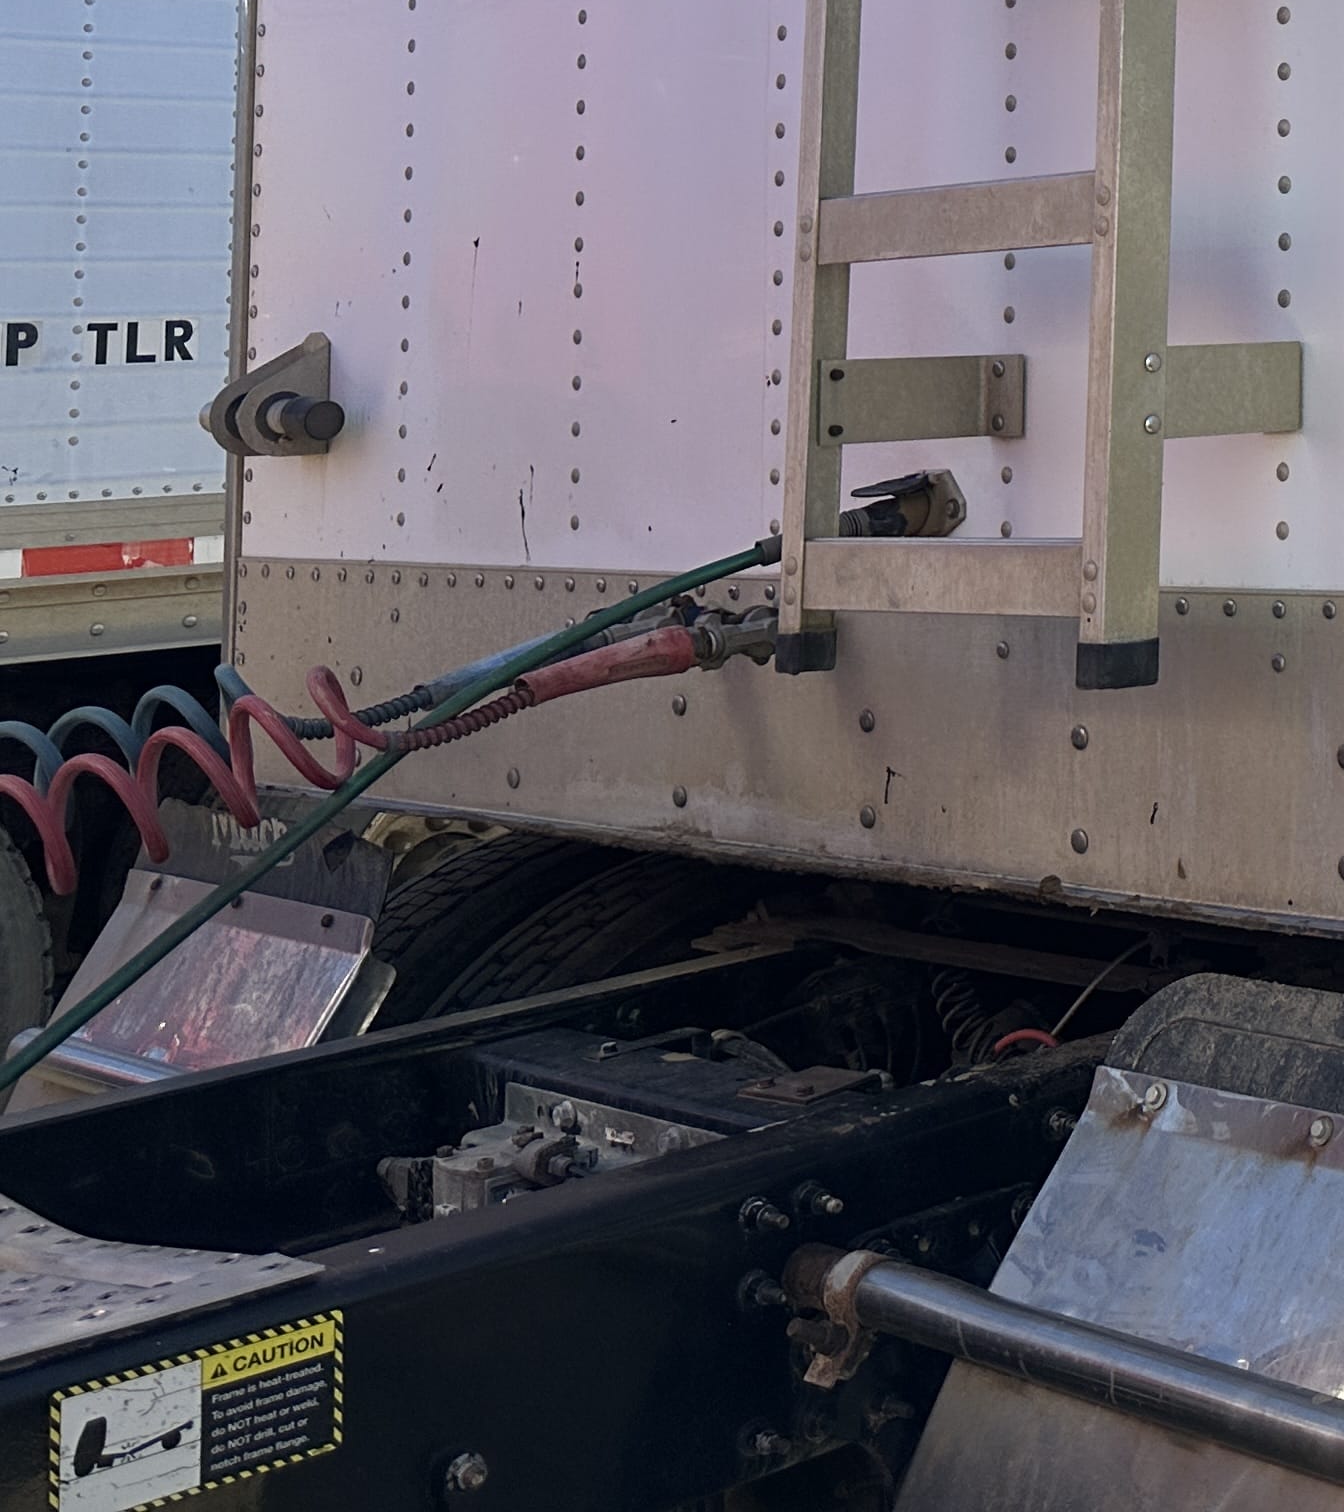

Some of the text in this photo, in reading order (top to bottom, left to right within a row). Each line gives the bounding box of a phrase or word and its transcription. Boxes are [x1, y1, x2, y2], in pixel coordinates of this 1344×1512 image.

[86, 319, 194, 365] TLR
[232, 1332, 324, 1372] CAUTION
[212, 1363, 324, 1404] Frame is heat-treated.
[211, 1427, 226, 1438] do
[228, 1417, 252, 1433] NOT
[254, 1410, 277, 1424] heat
[279, 1406, 290, 1416] or
[212, 1410, 224, 1420] To
[226, 1400, 253, 1416] avoid
[255, 1392, 284, 1407] frame
[210, 1444, 226, 1455] do
[227, 1434, 252, 1449] NOT
[278, 1421, 295, 1433] cut
[297, 1418, 308, 1427] or
[210, 1455, 241, 1471] notch
[243, 1445, 273, 1461] frame
